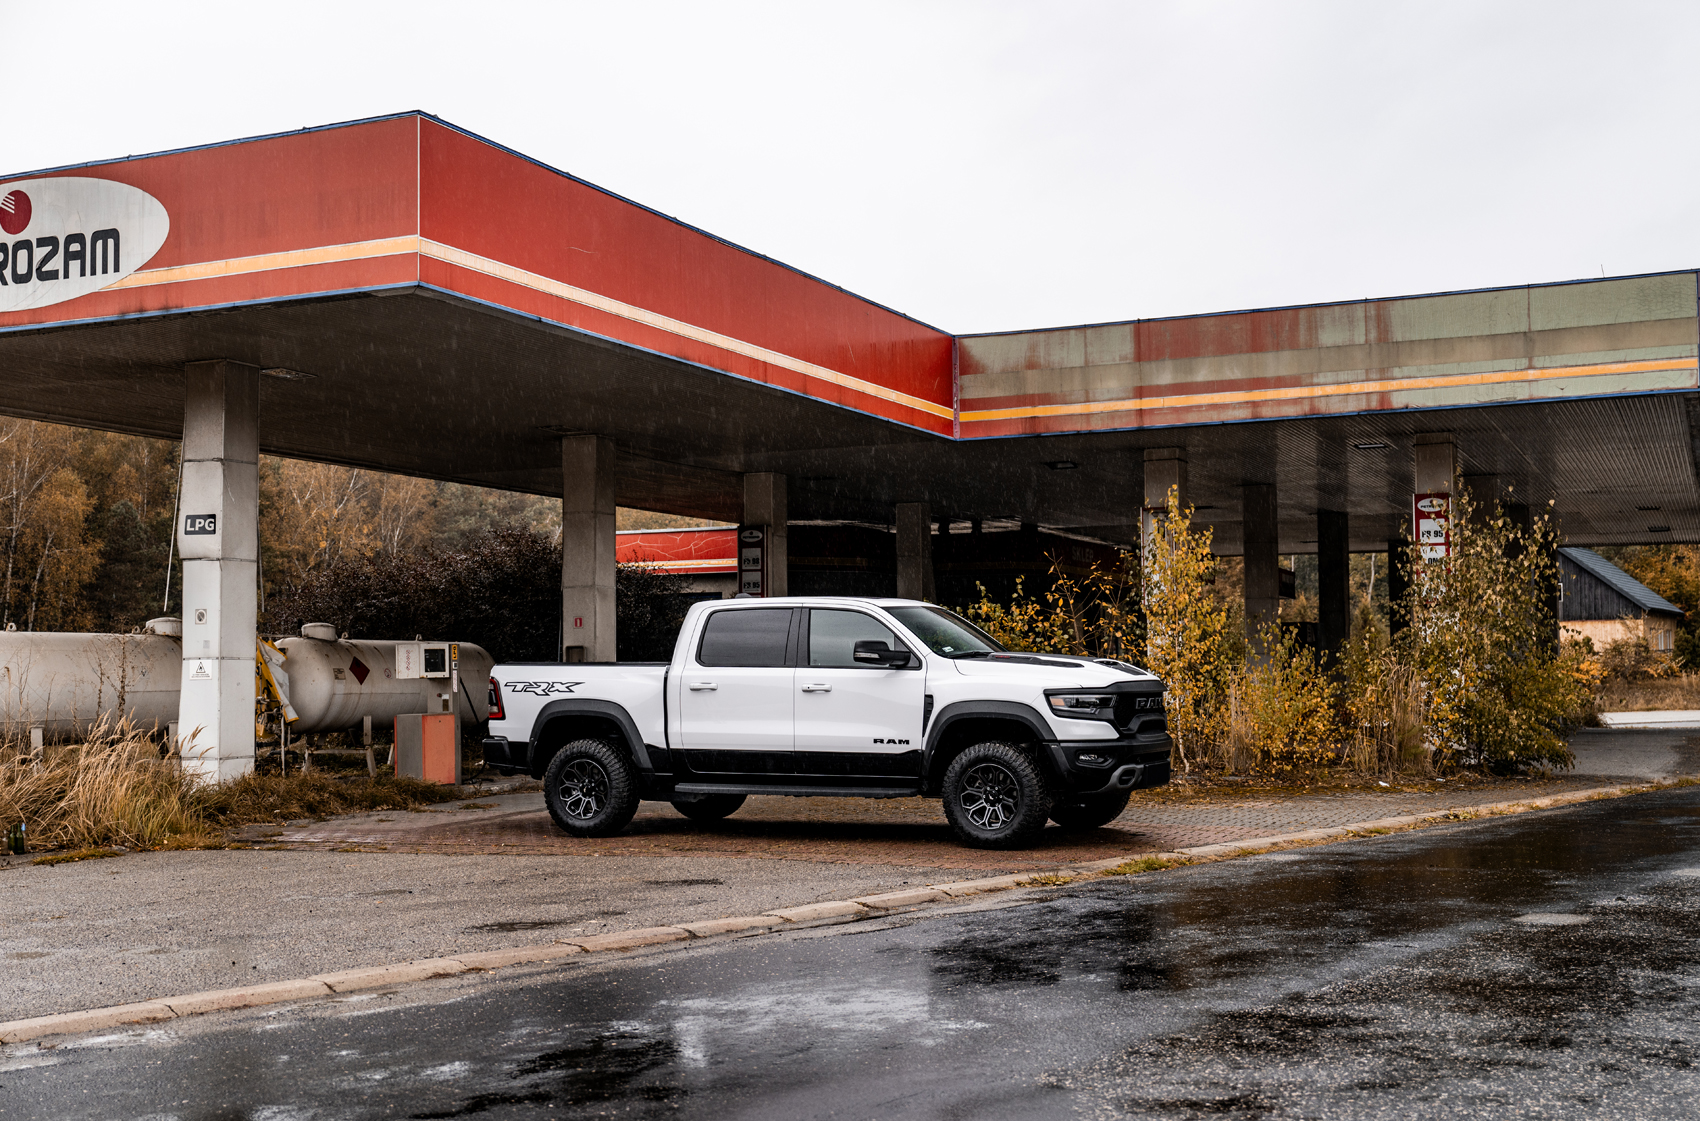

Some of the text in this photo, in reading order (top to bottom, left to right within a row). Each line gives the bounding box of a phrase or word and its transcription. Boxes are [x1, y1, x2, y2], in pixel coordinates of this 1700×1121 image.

[186, 518, 215, 531] LPG
[1434, 530, 1443, 538] 95
[504, 681, 585, 696] TRX
